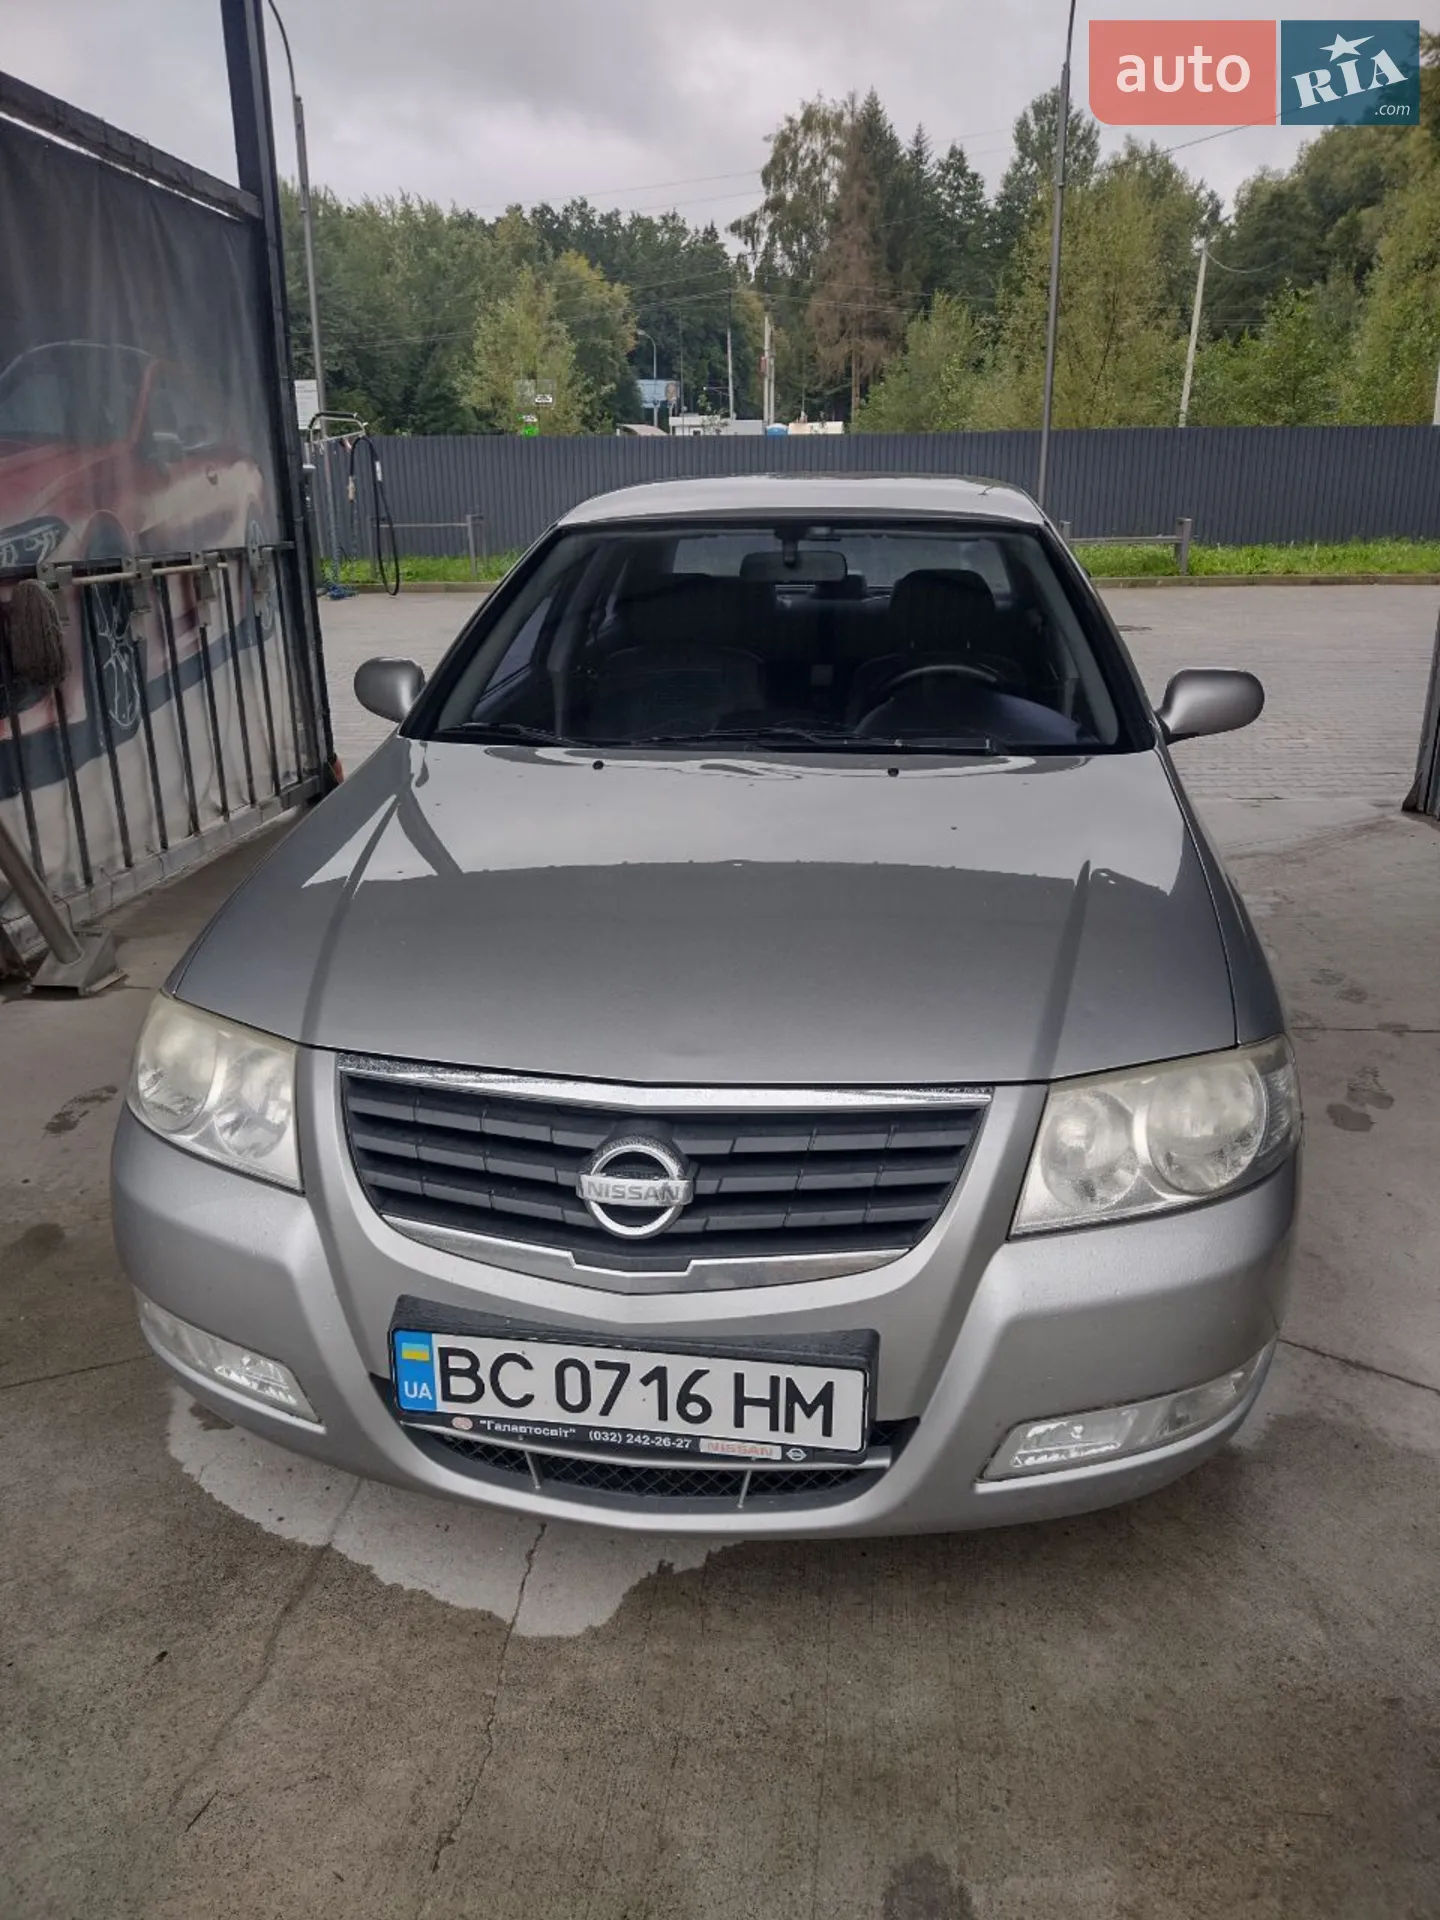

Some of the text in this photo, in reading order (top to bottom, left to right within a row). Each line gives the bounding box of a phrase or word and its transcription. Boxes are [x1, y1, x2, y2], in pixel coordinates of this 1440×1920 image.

[587, 1181, 679, 1201] NISSAN
[404, 1381, 432, 1400] UA
[437, 1346, 835, 1438] BC 0716 HM
[589, 1430, 692, 1449] (032) 242-26-27
[708, 1442, 773, 1456] NISSAN
